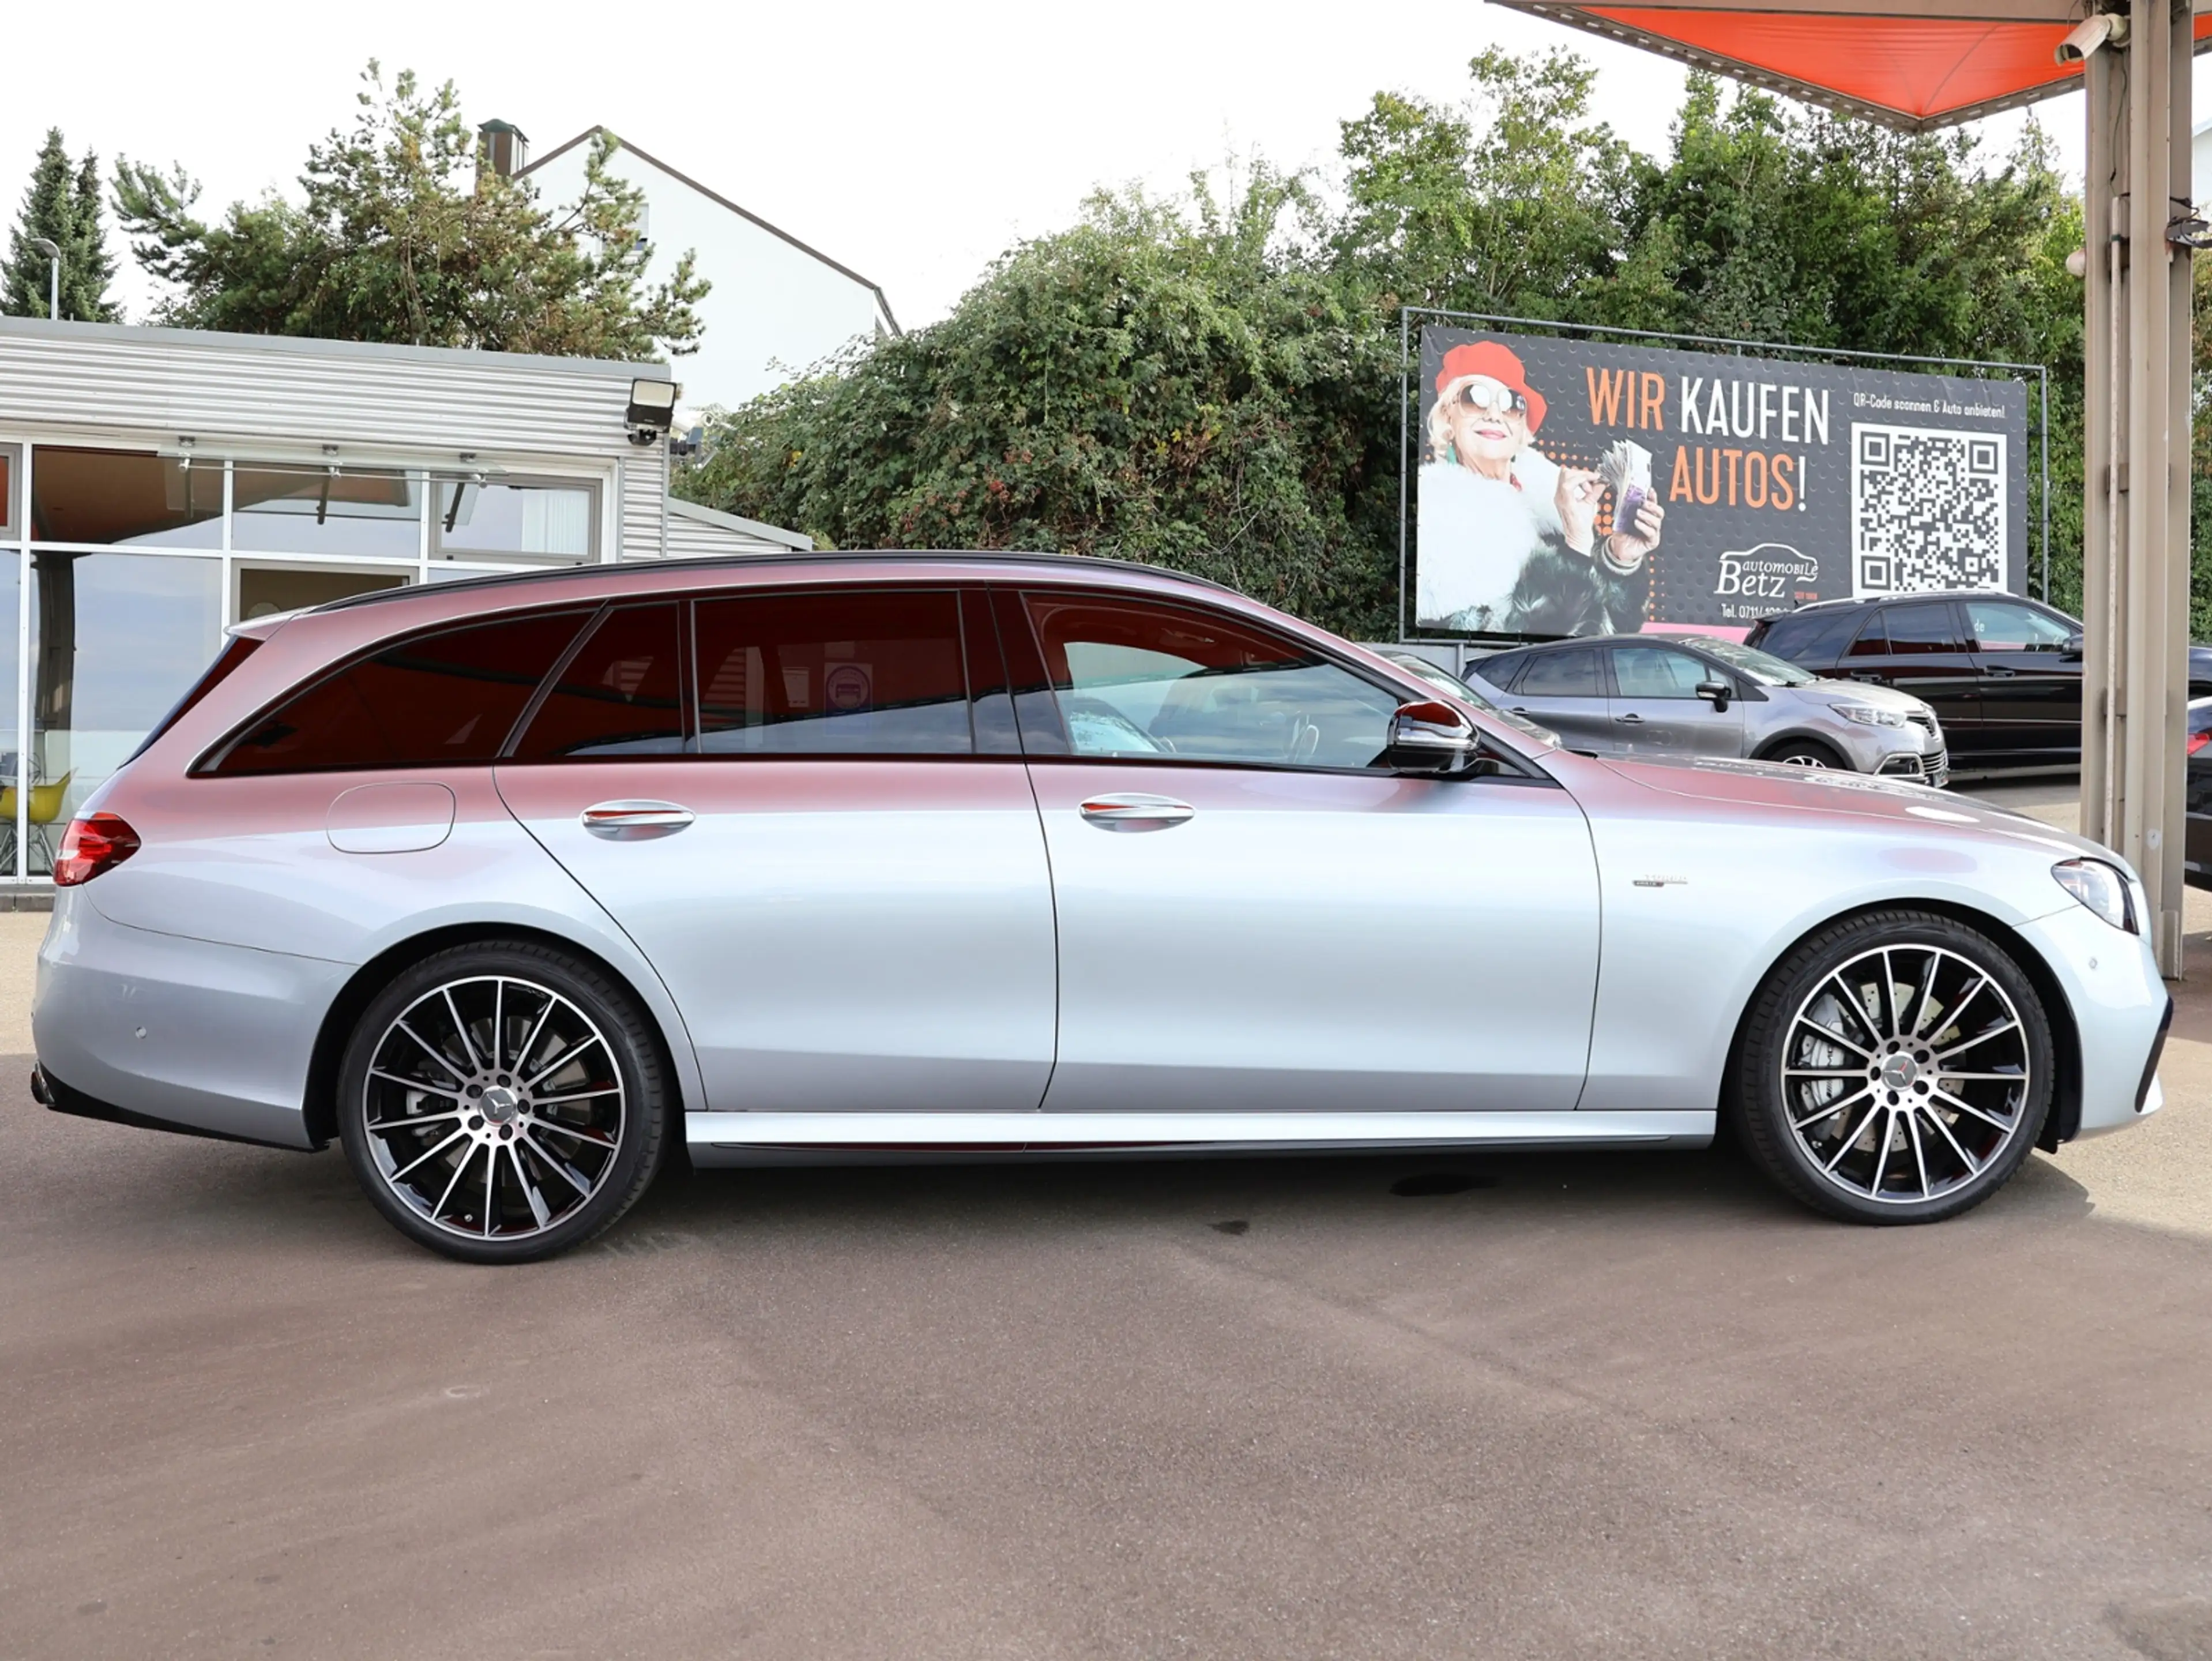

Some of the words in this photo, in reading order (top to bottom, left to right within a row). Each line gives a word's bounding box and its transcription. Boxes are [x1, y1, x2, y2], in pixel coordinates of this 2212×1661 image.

[1586, 367, 1665, 430] WIR
[1681, 376, 1829, 445] KAUFEN
[1853, 393, 1892, 409] QR-Code
[1894, 399, 1932, 412] scannen
[1933, 400, 1940, 413] &
[1942, 401, 1962, 415] Auto
[1963, 403, 2006, 418] anbieten!
[1669, 445, 1807, 512] AUTOS!
[1713, 559, 1786, 598] Betz
[1721, 603, 1737, 618] Tel.
